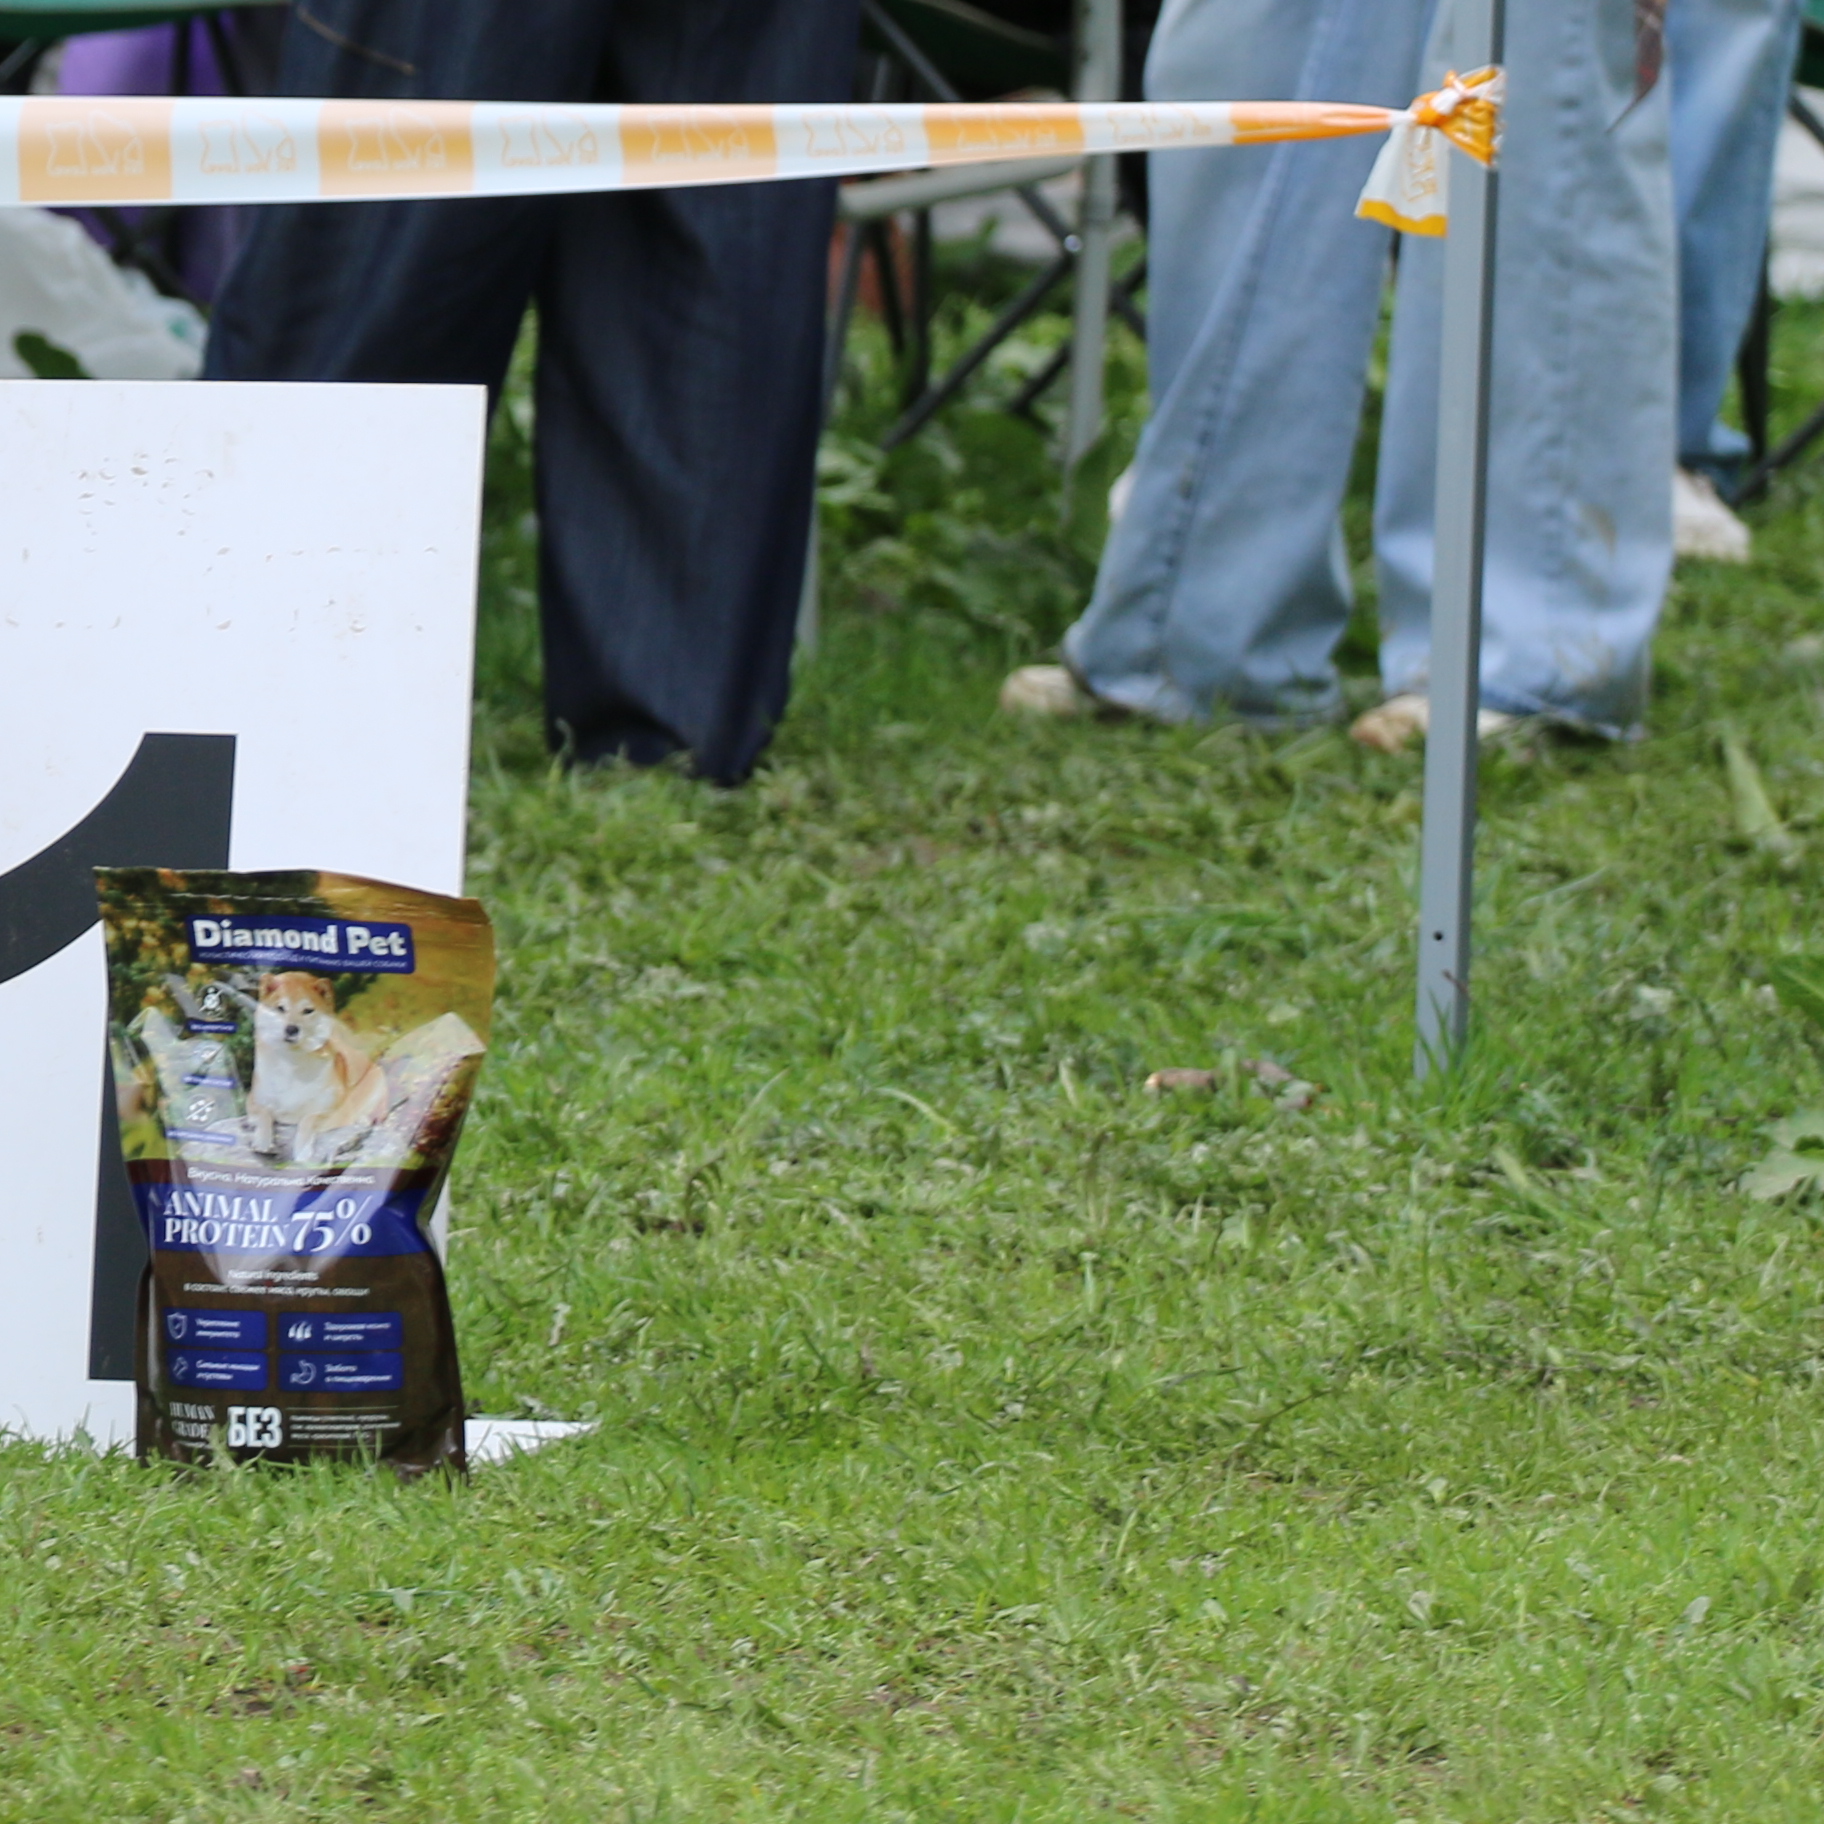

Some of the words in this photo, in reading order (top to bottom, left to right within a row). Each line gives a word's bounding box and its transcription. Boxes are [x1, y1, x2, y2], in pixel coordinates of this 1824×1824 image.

[193, 919, 339, 954] Diamond
[346, 925, 407, 956] Pet
[163, 1190, 279, 1223] ANIMAL
[291, 1196, 373, 1253] 75%
[164, 1217, 290, 1249] PROTEIN
[227, 1406, 283, 1449] БЕЗ
